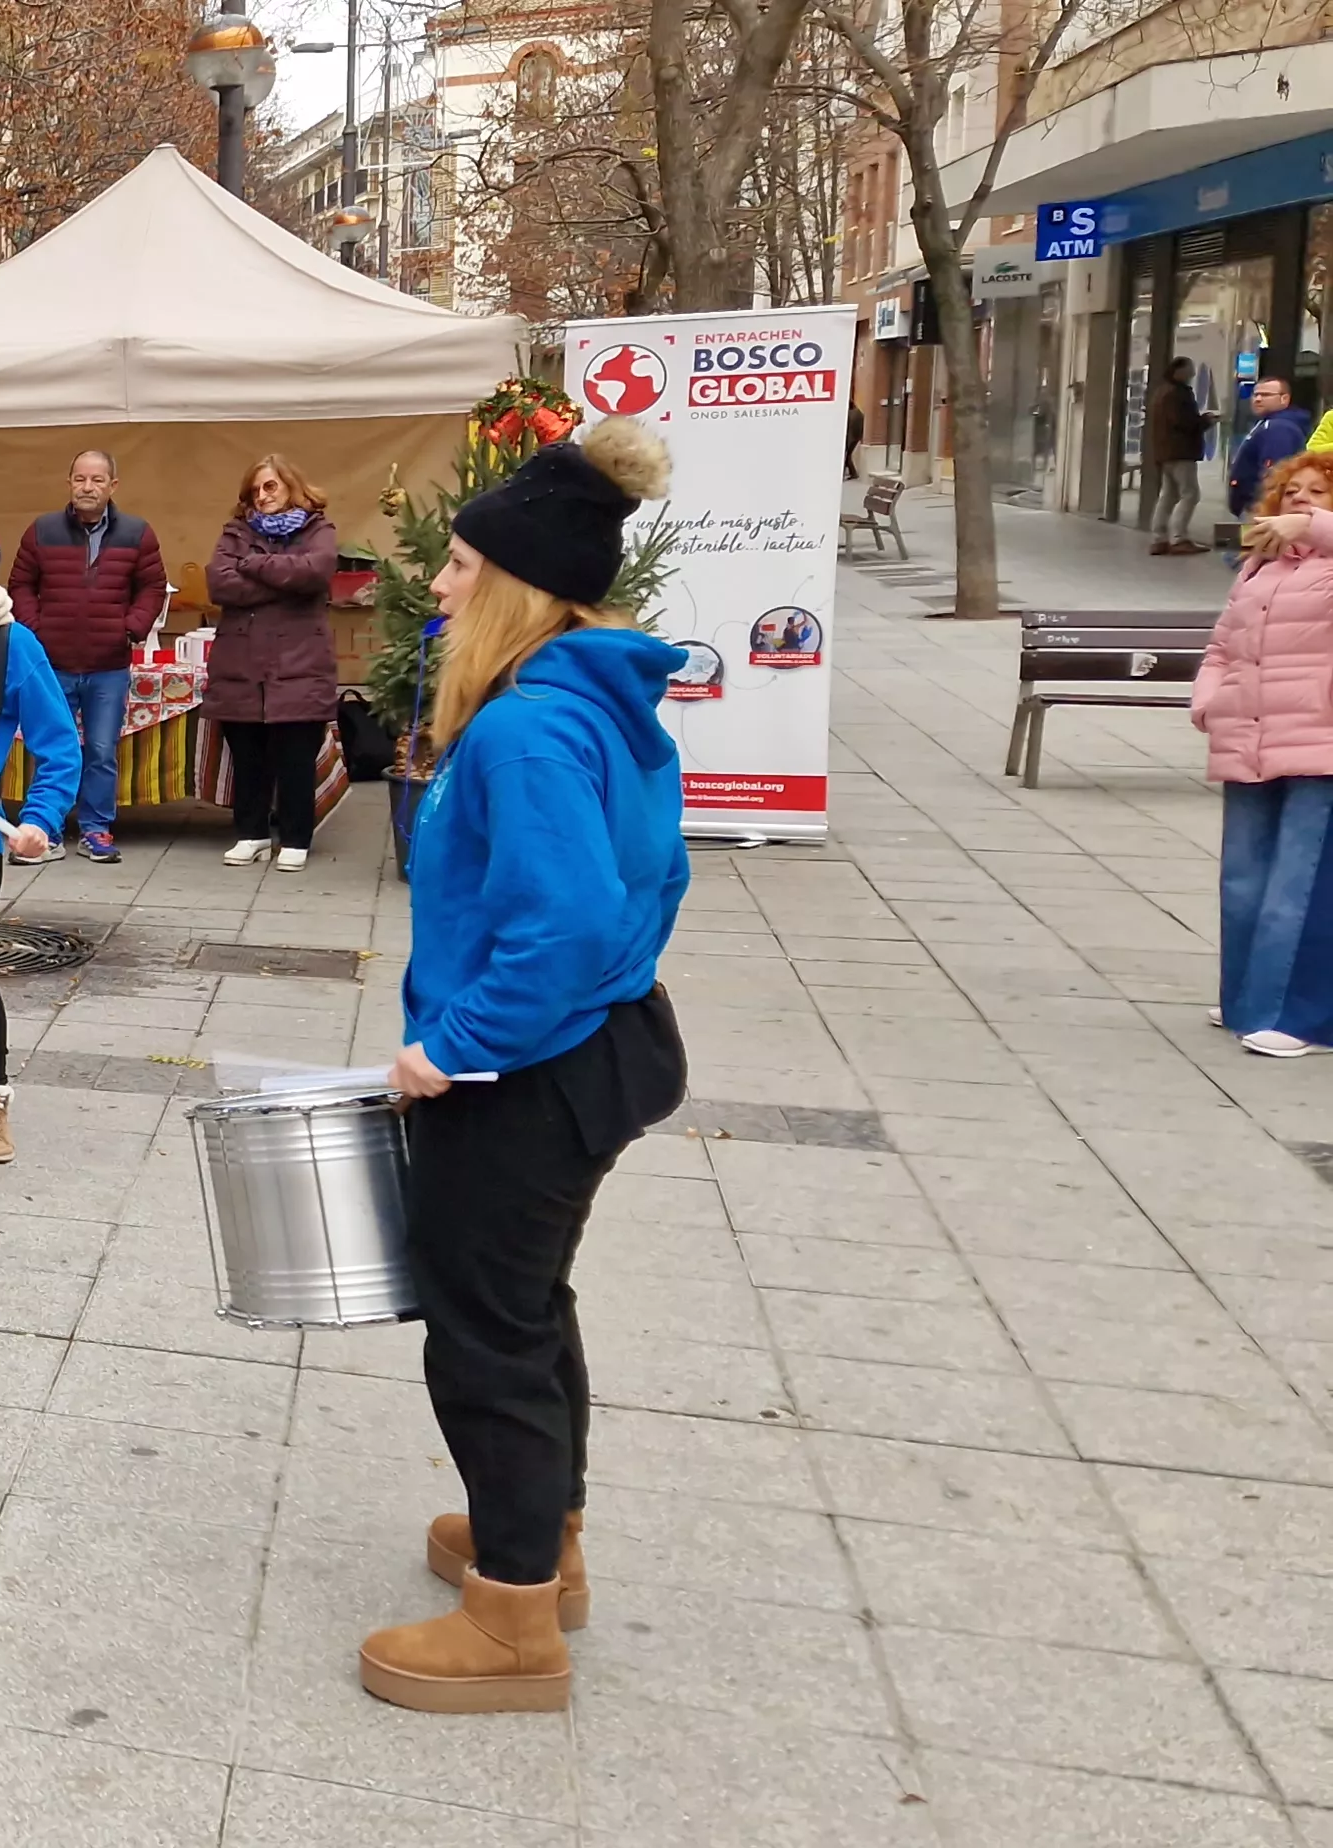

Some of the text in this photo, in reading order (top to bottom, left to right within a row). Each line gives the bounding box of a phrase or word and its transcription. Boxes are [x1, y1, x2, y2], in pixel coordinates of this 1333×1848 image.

[1070, 207, 1096, 235] S
[1045, 239, 1095, 257] ATM
[981, 273, 1033, 284] LACOSTE
[695, 329, 802, 345] ENTARACHEN
[693, 342, 823, 372] BOSCO
[691, 374, 831, 404] GLOBAL
[690, 408, 799, 420] ONGD SALESIANA
[689, 780, 785, 793] boscoglobal.org
